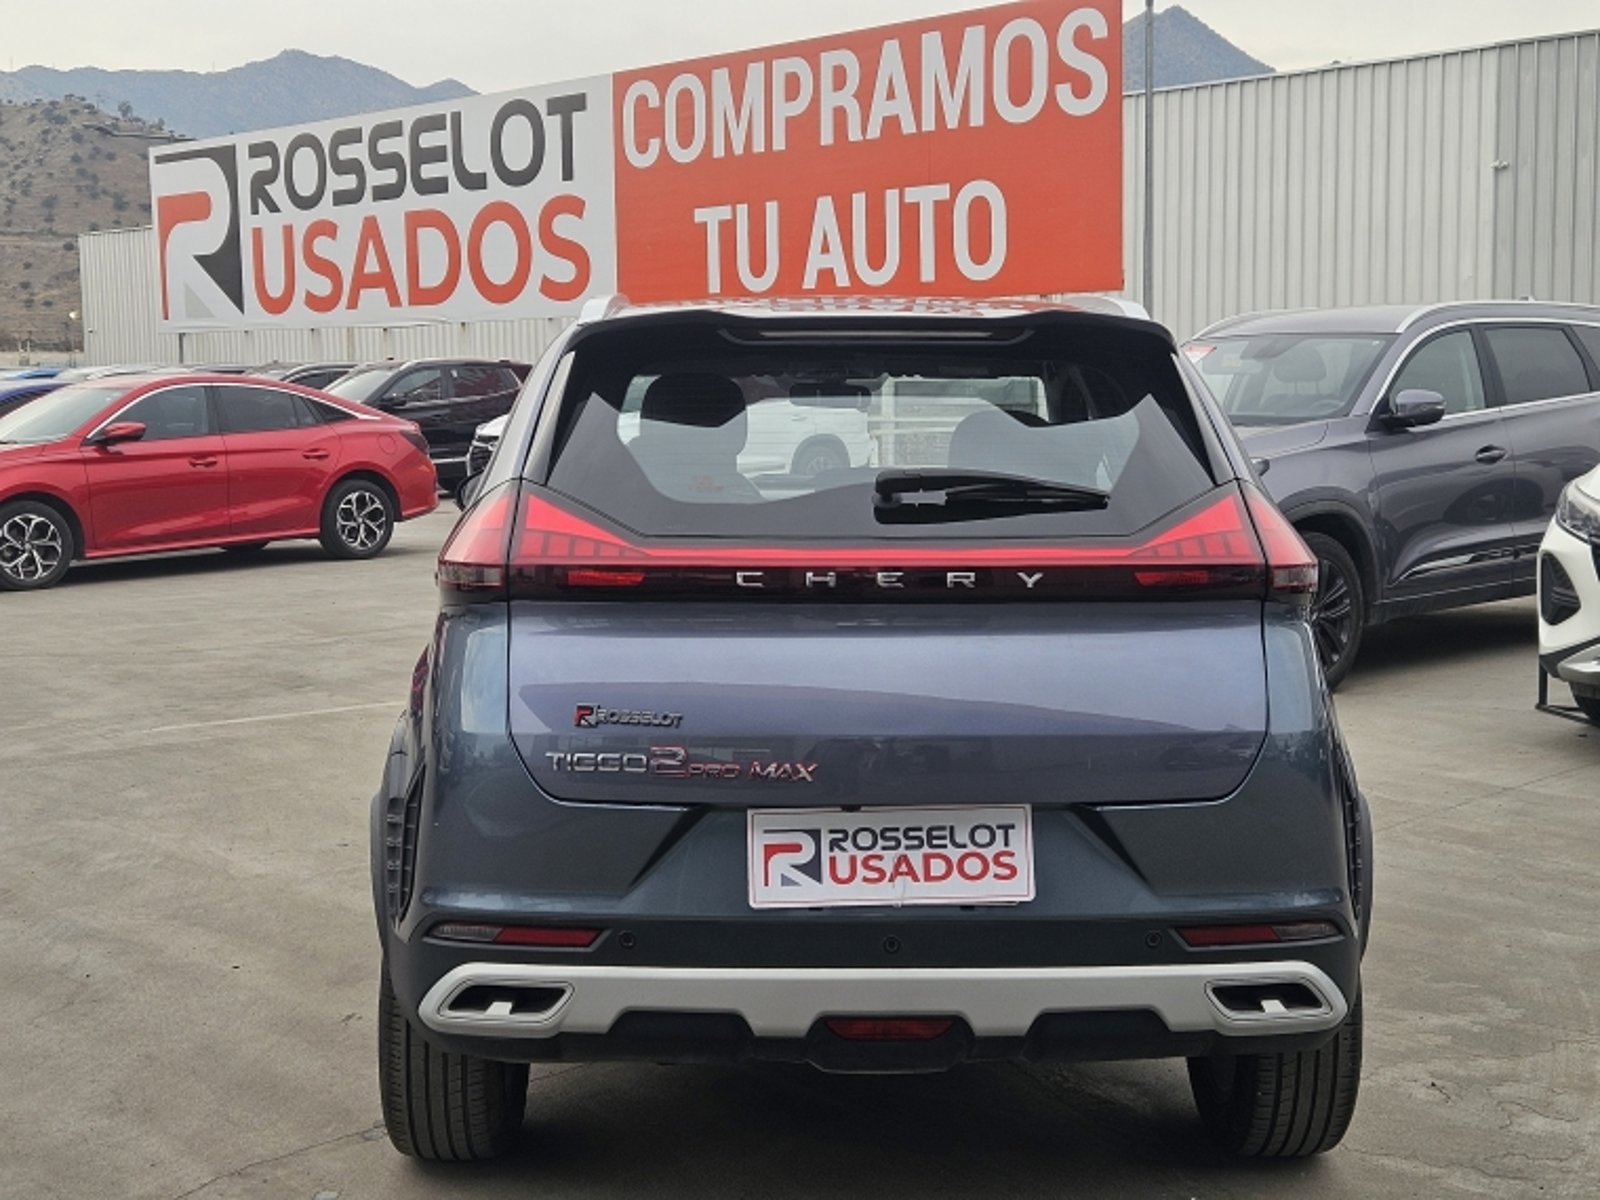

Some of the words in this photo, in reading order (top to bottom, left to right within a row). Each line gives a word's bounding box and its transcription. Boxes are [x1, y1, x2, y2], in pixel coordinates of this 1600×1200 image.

[622, 8, 1108, 168] COMPRAMOS
[248, 93, 588, 216] ROSSELOT
[252, 194, 592, 316] USADOS
[694, 201, 779, 294] TU
[802, 180, 1008, 289] AUTO
[736, 571, 1044, 588] CHERY
[546, 752, 647, 772] TIGGO
[687, 763, 741, 777] PRO
[750, 761, 818, 783] MAX
[828, 824, 1015, 852] ROSSELOT
[829, 850, 1018, 885] USADOS
